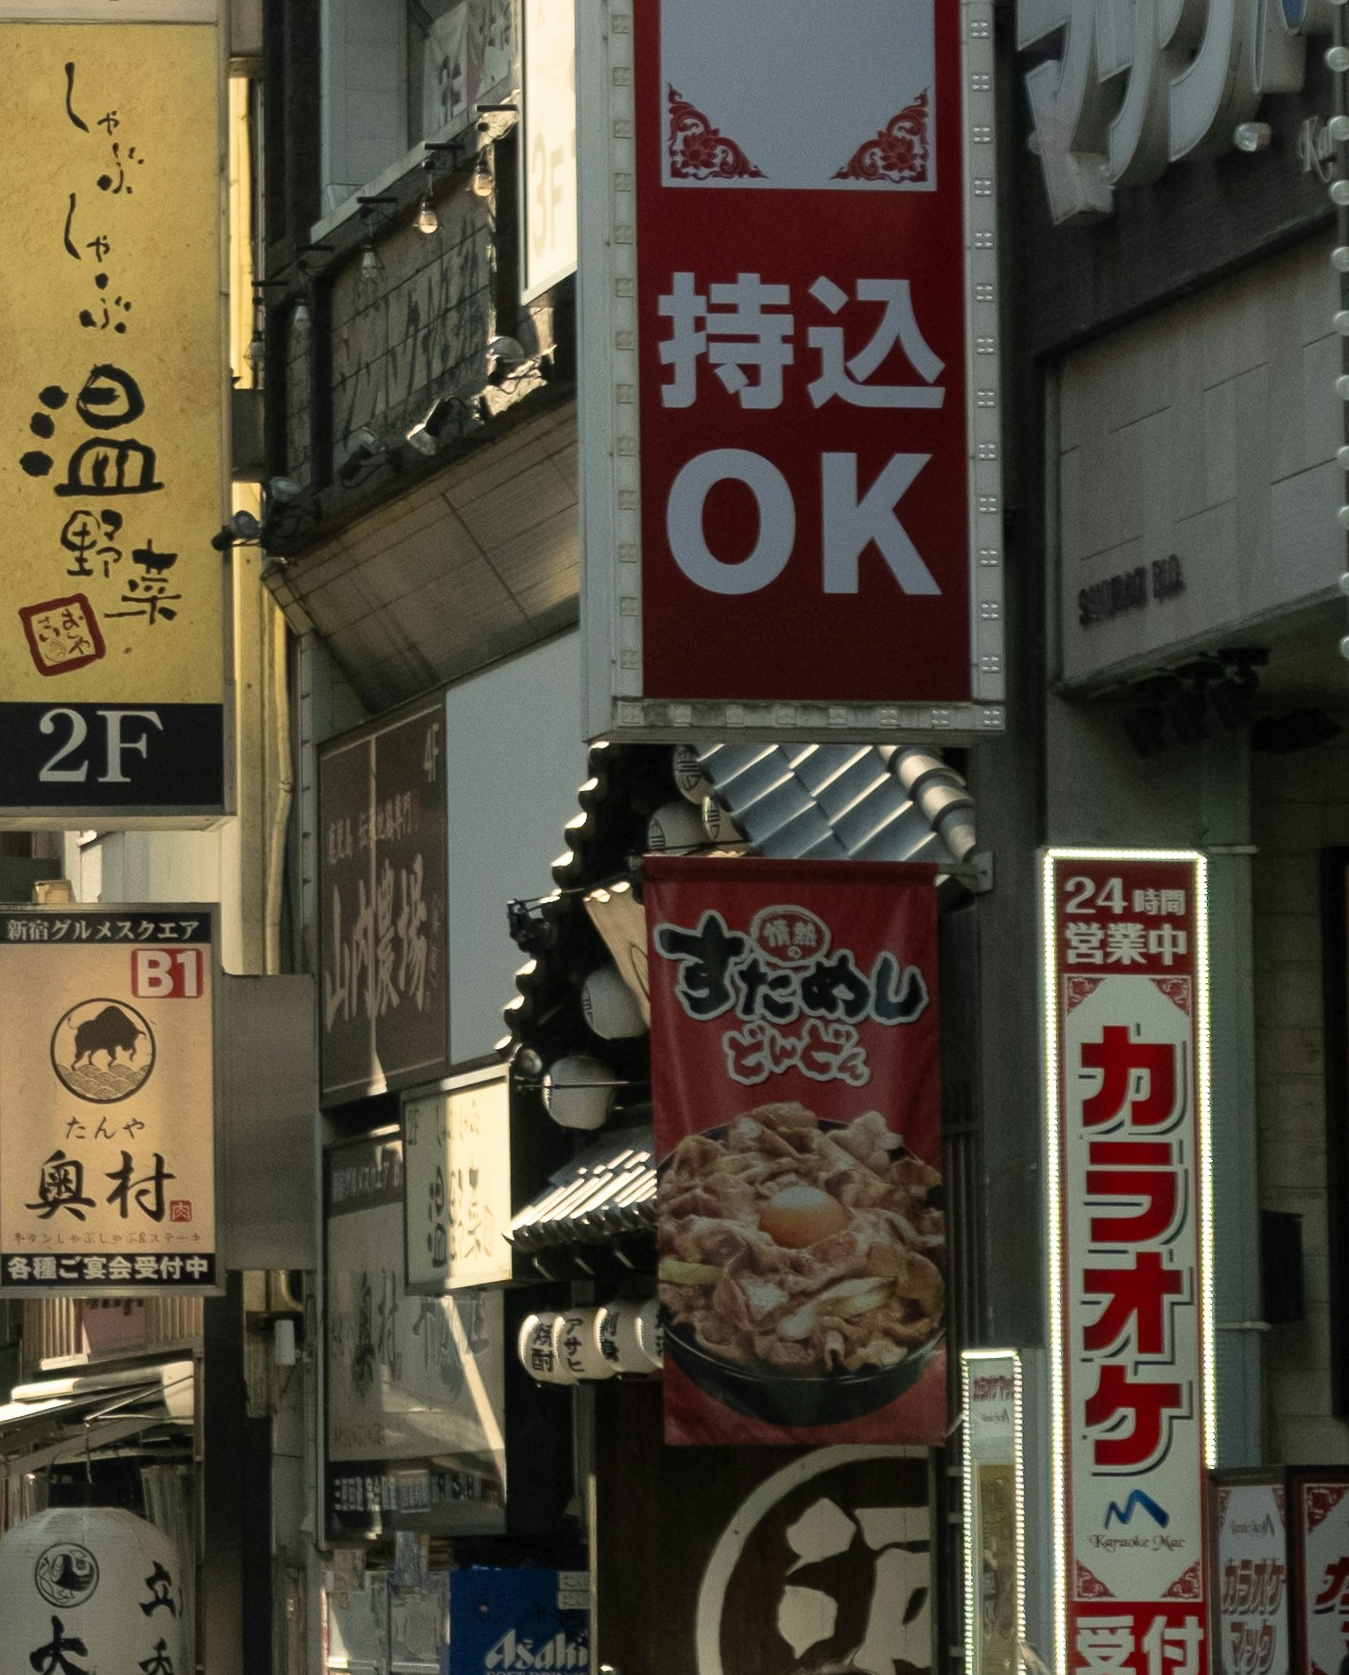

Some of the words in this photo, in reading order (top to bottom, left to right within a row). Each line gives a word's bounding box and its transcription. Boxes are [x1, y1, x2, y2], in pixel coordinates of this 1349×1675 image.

[64, 61, 144, 335] しゃぶしゃぶ
[658, 271, 947, 411] 持込
[19, 363, 184, 625] 温野菜
[665, 447, 943, 596] OK
[36, 707, 165, 784] 2F
[1064, 876, 1187, 917] 24時間
[6, 919, 200, 943] 新宿グルメスクエア
[1065, 921, 1190, 967] 営業中
[135, 949, 198, 998] B1
[65, 1115, 146, 1141] たんや
[23, 1148, 178, 1223] 奥村
[170, 1201, 191, 1222] 肉
[6, 1255, 209, 1281] 各種ご宴会受付中
[1079, 1023, 1189, 1476] カラオケ
[564, 1316, 588, 1373] アサヒ
[1089, 1533, 1151, 1552] Karaoke
[1153, 1533, 1187, 1551] Mac
[1222, 1556, 1286, 1617] カラオケ
[484, 1627, 589, 1670] Asahi
